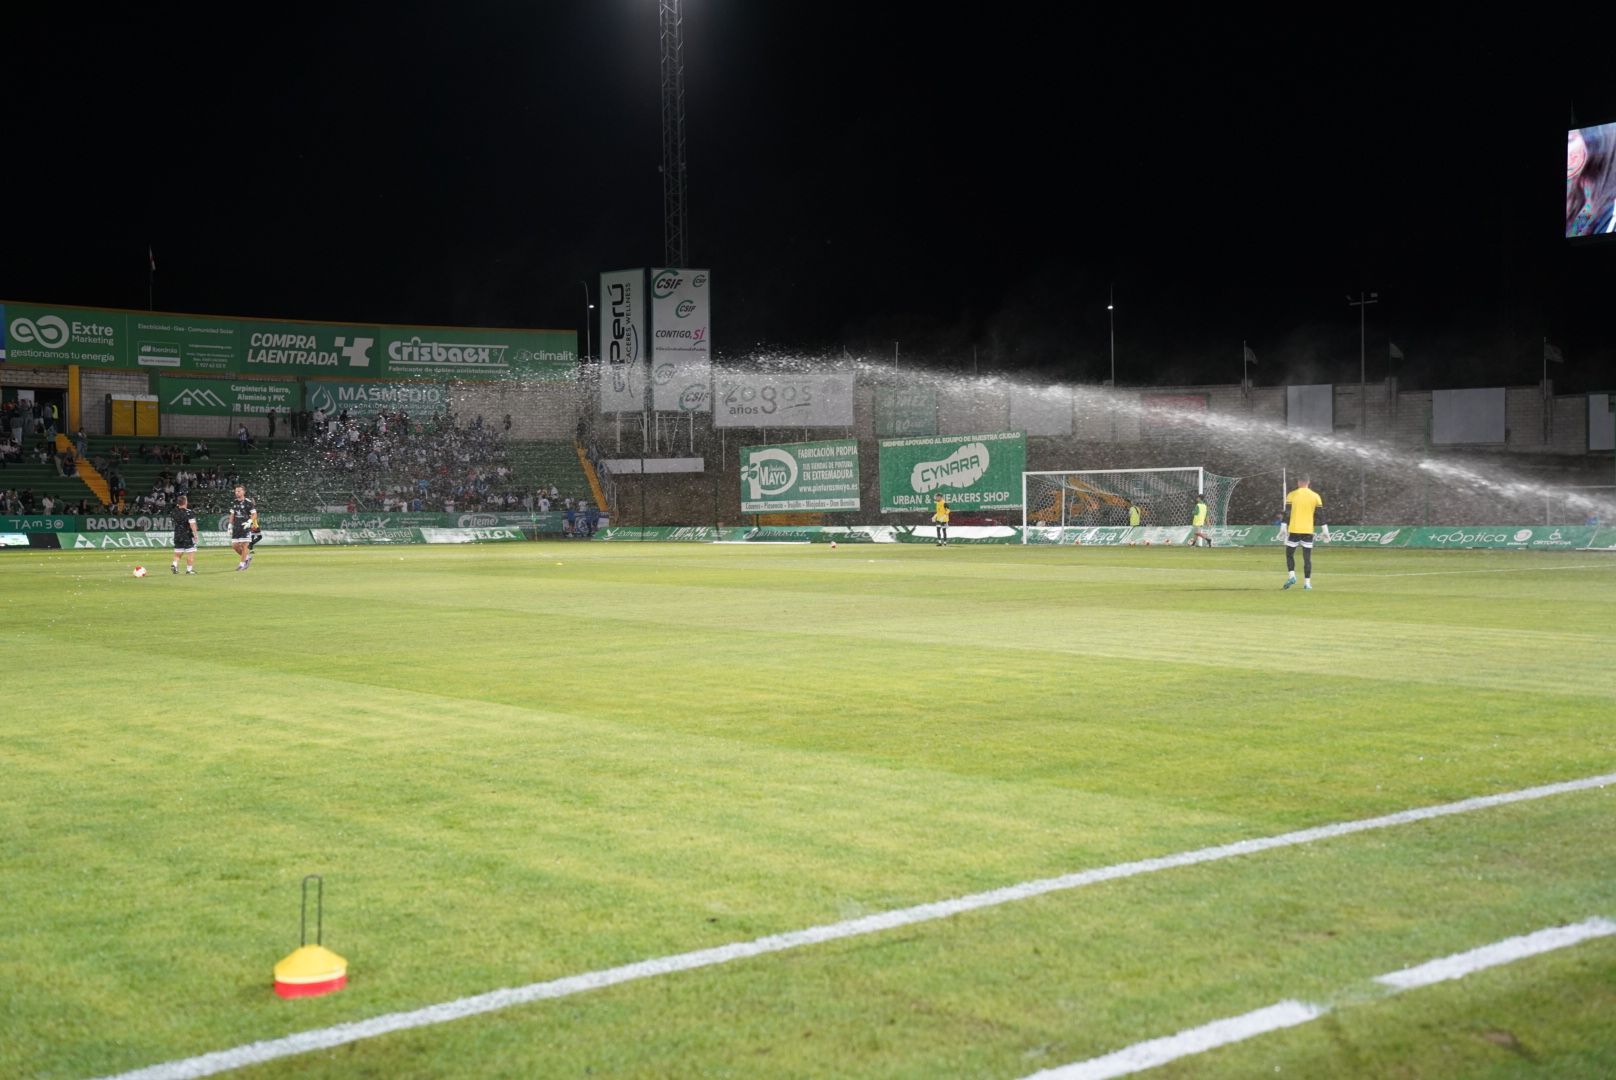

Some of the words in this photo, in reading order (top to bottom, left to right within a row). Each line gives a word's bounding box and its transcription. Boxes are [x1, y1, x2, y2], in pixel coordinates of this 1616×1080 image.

[656, 278, 683, 289] CSIF
[624, 281, 632, 325] WELLNESS
[680, 305, 697, 313] CSIF
[71, 321, 114, 337] Extre
[71, 335, 115, 346] Marketing
[250, 332, 317, 350] COMPRA
[10, 349, 70, 360] gestionamos
[71, 351, 81, 359] tu
[81, 352, 116, 363] energía
[388, 335, 491, 364] Crisbaex
[533, 349, 574, 362] climalit
[247, 348, 339, 367] LAENTRADA
[237, 393, 266, 402] Aluminio
[728, 404, 759, 415] años
[835, 445, 858, 456] PROPIA
[812, 468, 854, 480] EXTREMADURA
[920, 454, 980, 484] CYNARA
[760, 466, 787, 486] MAYO
[893, 495, 923, 506] URBAN
[925, 495, 931, 504] &
[934, 492, 981, 504] EAKERS
[984, 491, 1010, 503] SHOP
[86, 519, 135, 530] RADIO
